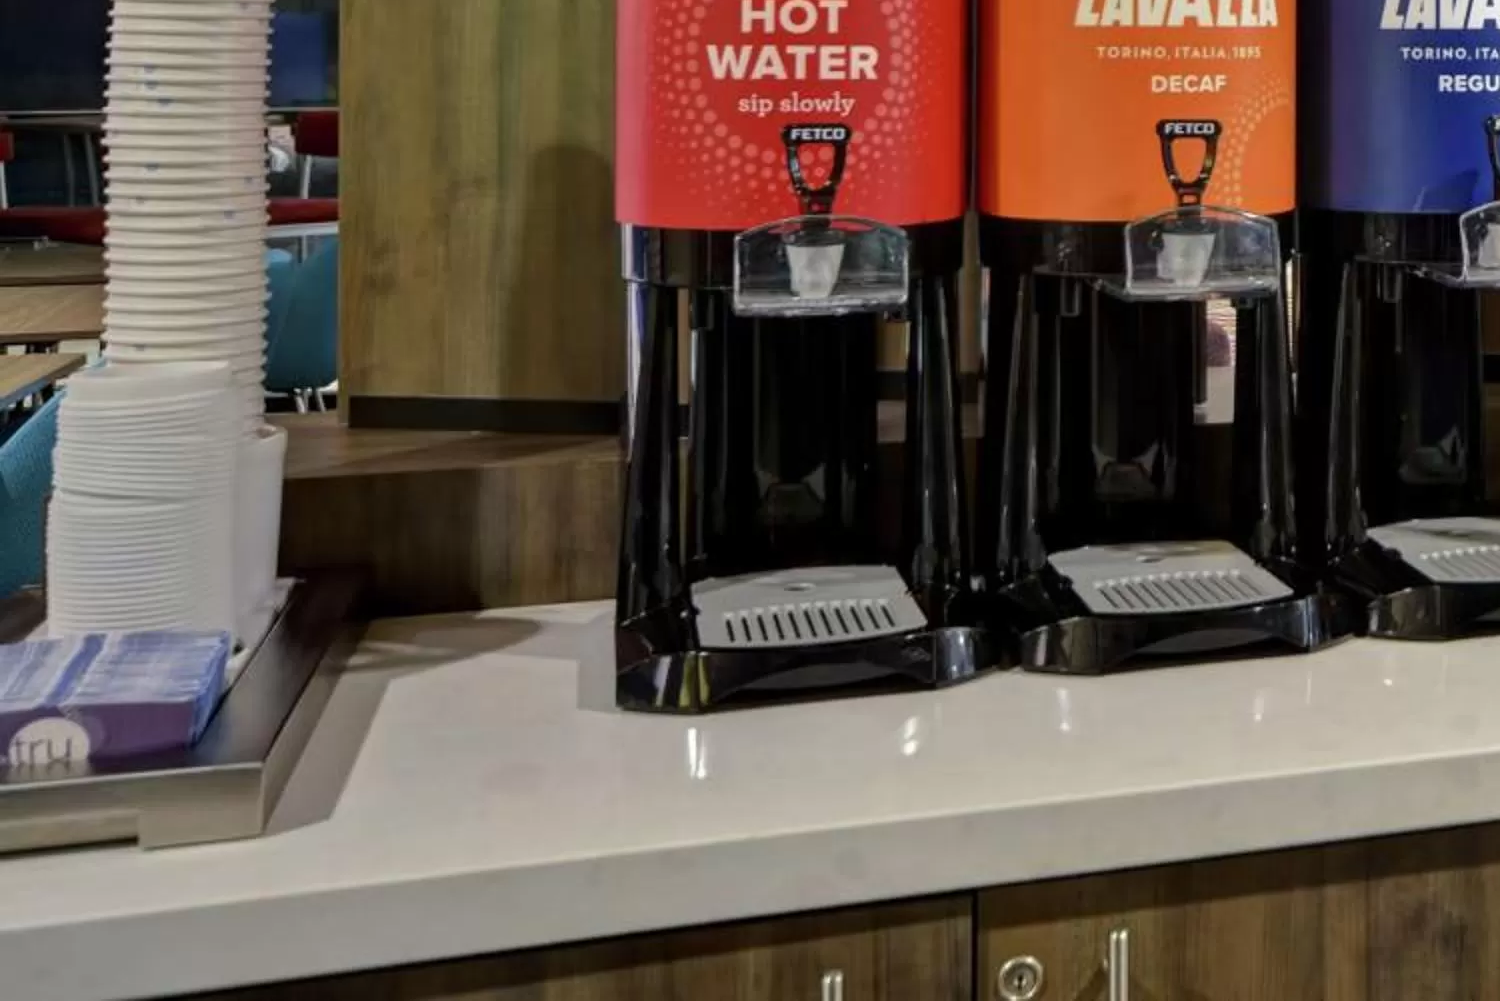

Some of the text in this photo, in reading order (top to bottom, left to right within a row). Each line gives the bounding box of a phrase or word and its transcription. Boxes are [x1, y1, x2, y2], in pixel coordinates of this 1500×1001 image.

[706, 44, 880, 80] WATER
[1151, 74, 1228, 94] DECAF
[737, 91, 857, 117] sip slowly
[791, 127, 846, 140] FETCO
[1163, 122, 1216, 135] FETCO
